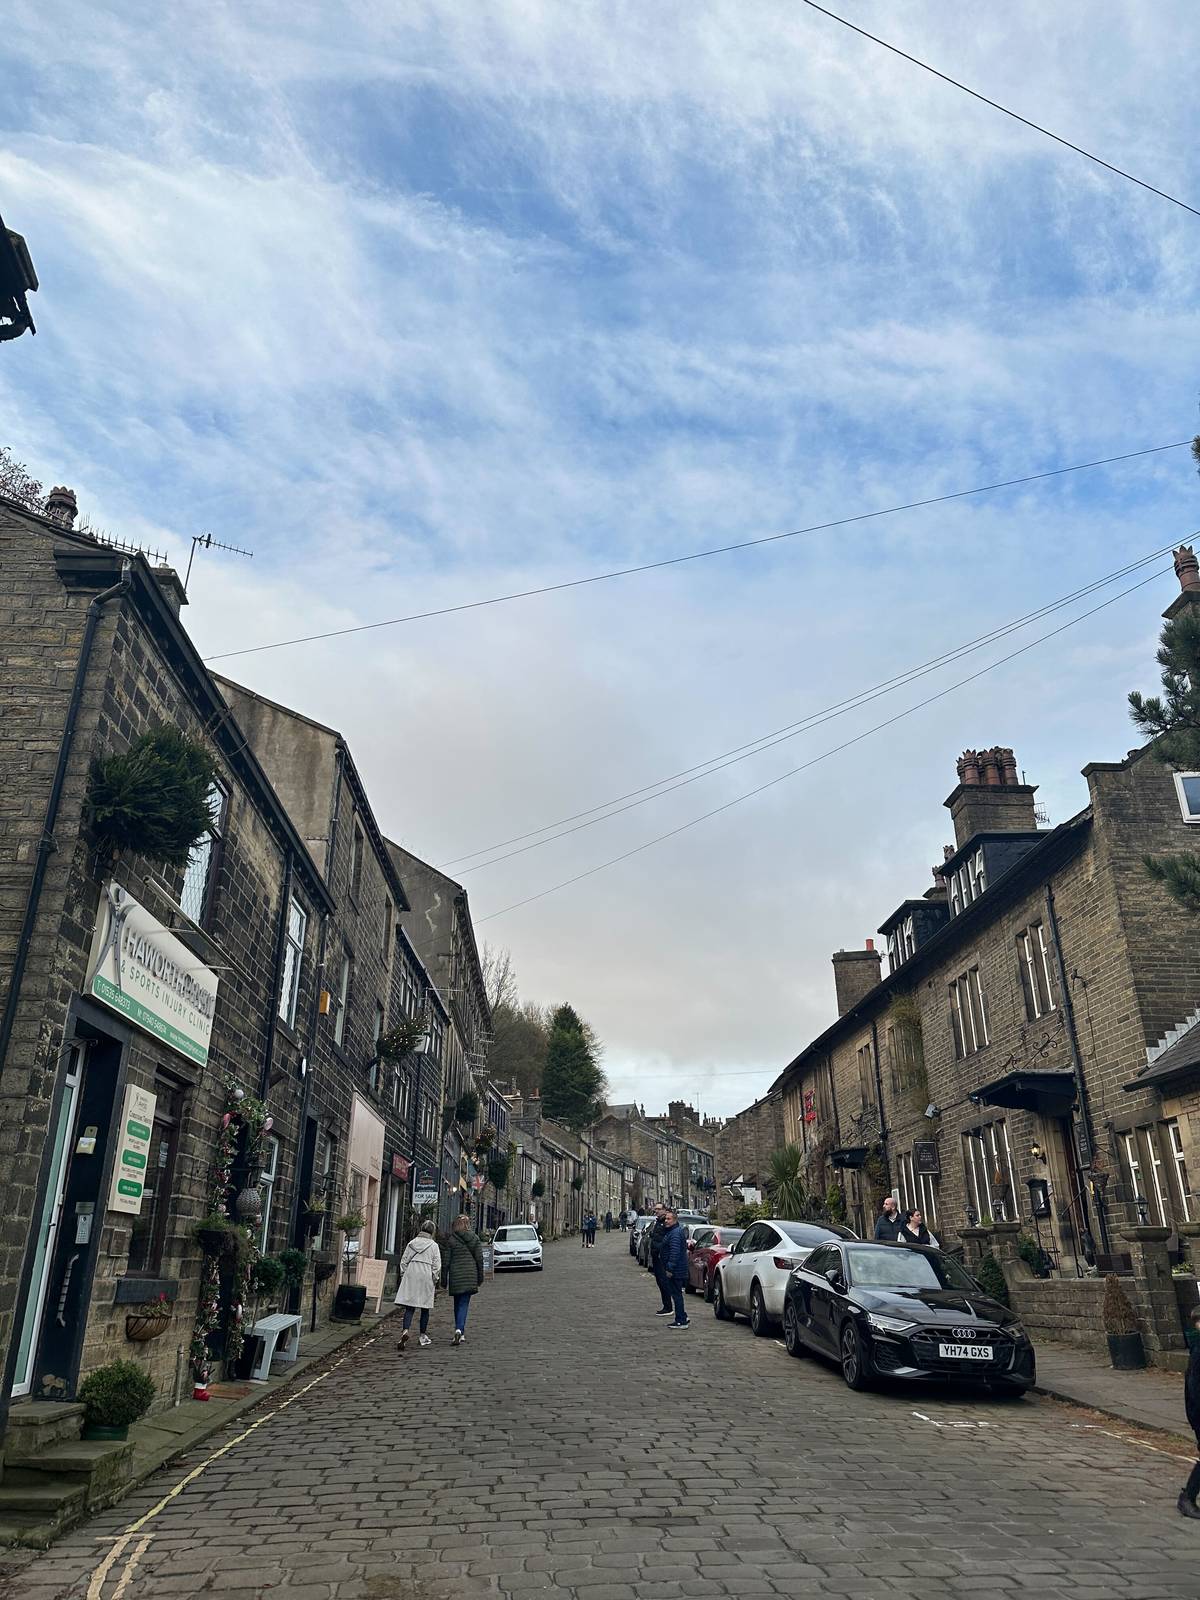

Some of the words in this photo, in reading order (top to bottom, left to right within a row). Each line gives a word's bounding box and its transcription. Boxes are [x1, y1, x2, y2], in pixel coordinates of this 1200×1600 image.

[121, 959, 126, 974] &
[129, 966, 160, 998] SPORTS
[161, 991, 187, 1017] INJURY
[188, 1010, 210, 1037] CLINIC
[944, 1345, 968, 1357] YH74
[970, 1346, 989, 1358] GXS
